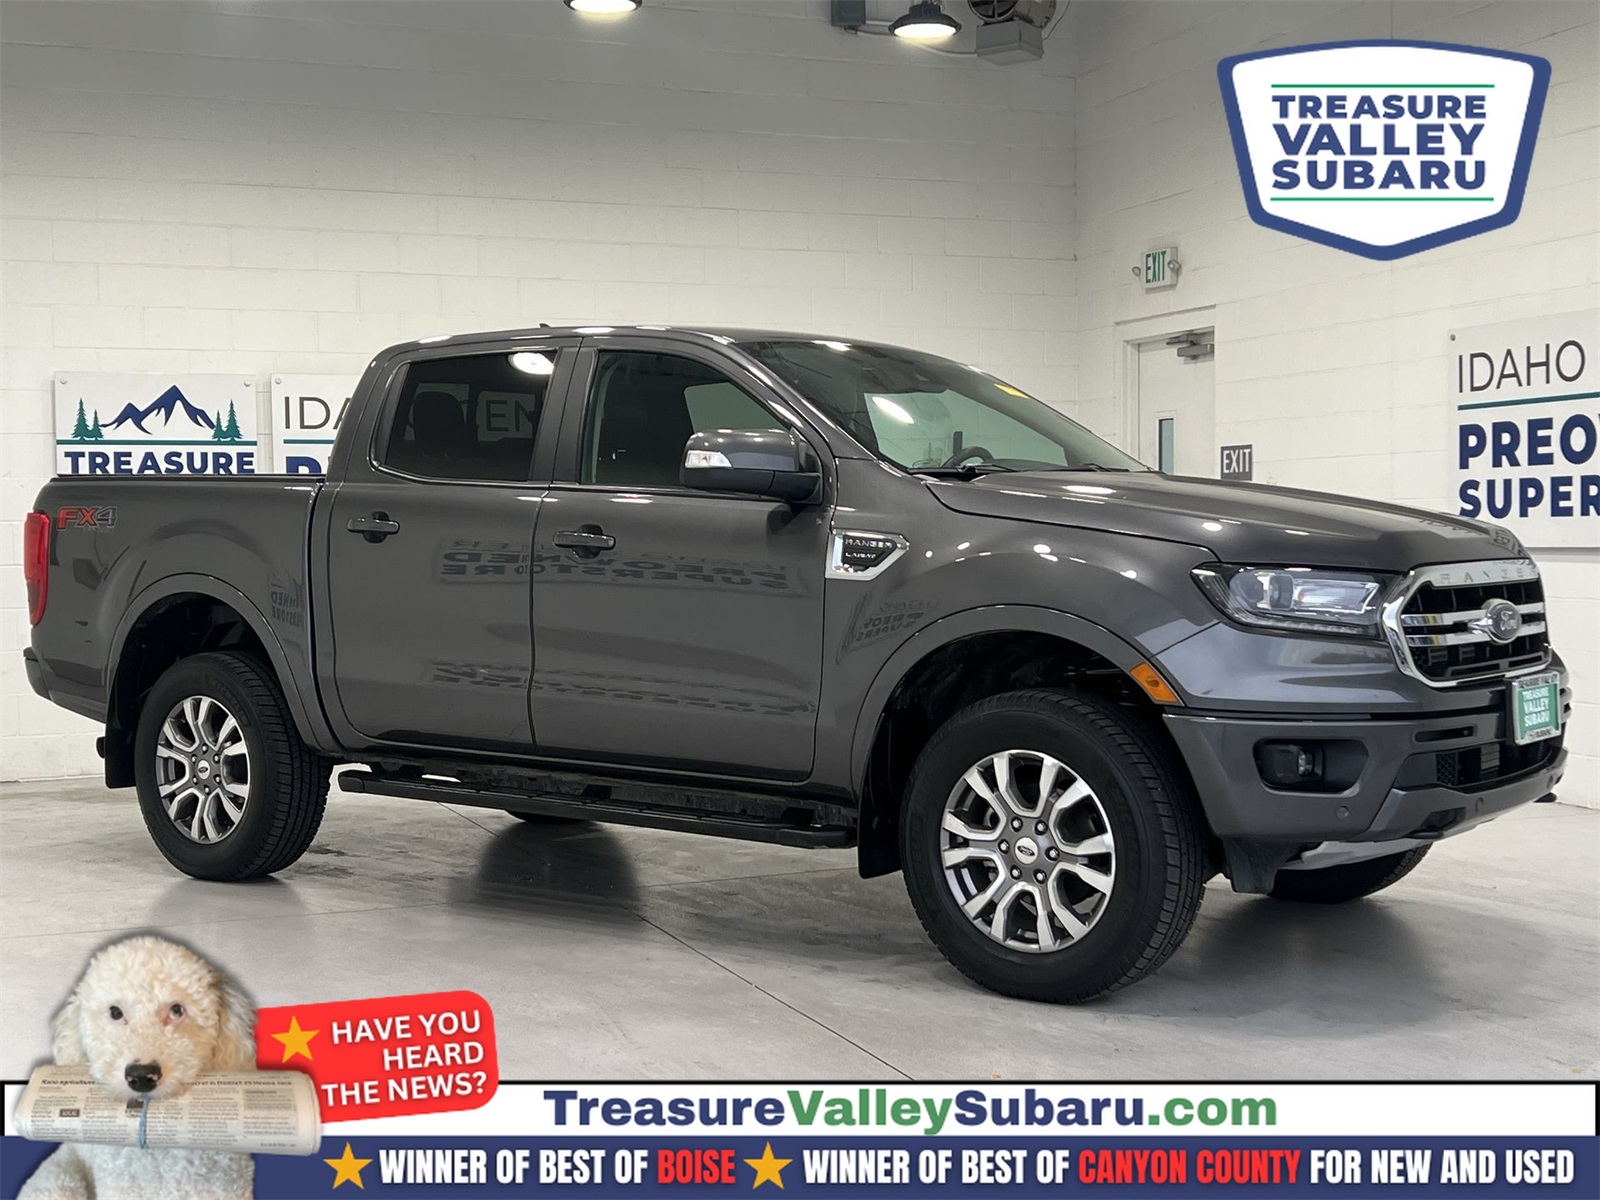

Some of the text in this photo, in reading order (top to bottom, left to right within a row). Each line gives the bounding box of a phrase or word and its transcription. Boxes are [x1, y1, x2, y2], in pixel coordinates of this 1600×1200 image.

[1145, 250, 1167, 284] EXIT
[1458, 340, 1586, 394] IDAHO
[63, 450, 255, 475] TREASURE
[1222, 448, 1252, 475] EXIT
[57, 505, 118, 531] FX4
[1523, 697, 1550, 714] VALLEY
[1524, 710, 1550, 728] SUBARU
